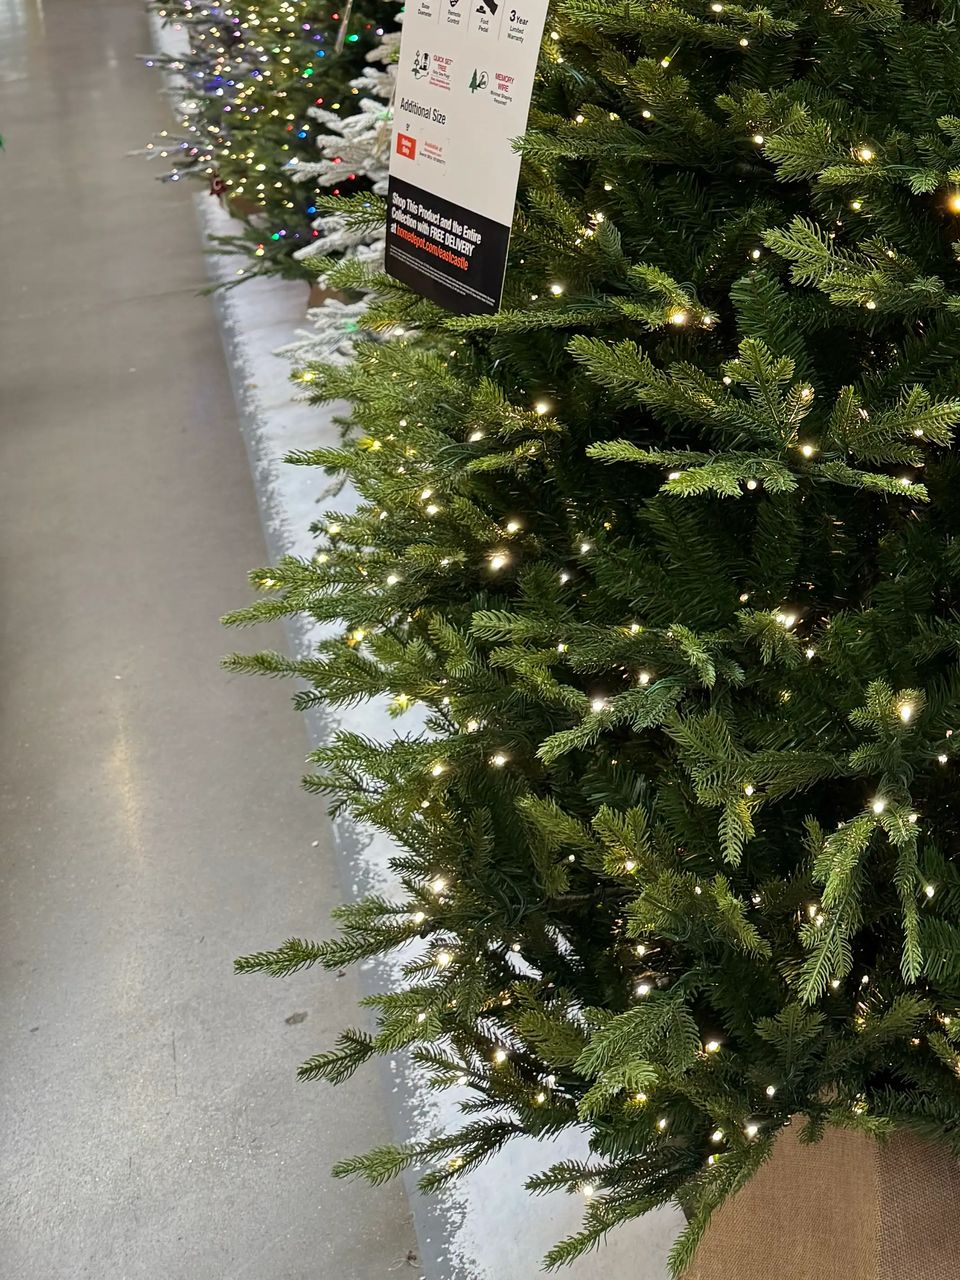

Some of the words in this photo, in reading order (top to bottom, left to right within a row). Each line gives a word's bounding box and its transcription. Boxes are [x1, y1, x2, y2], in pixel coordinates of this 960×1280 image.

[509, 10, 517, 22] 3
[516, 16, 530, 27] Year
[495, 72, 514, 84] MEMORY
[498, 82, 510, 93] WIRE
[400, 97, 432, 120] Additional
[432, 108, 446, 126] Size
[391, 206, 416, 230] Collection
[416, 221, 430, 236] with
[430, 226, 445, 244] FREE
[392, 192, 406, 210] Shop
[406, 198, 418, 214] This
[418, 204, 440, 224] Product
[440, 216, 452, 230] and
[452, 221, 462, 236] the
[462, 225, 482, 244] Entire
[390, 222, 396, 234] at
